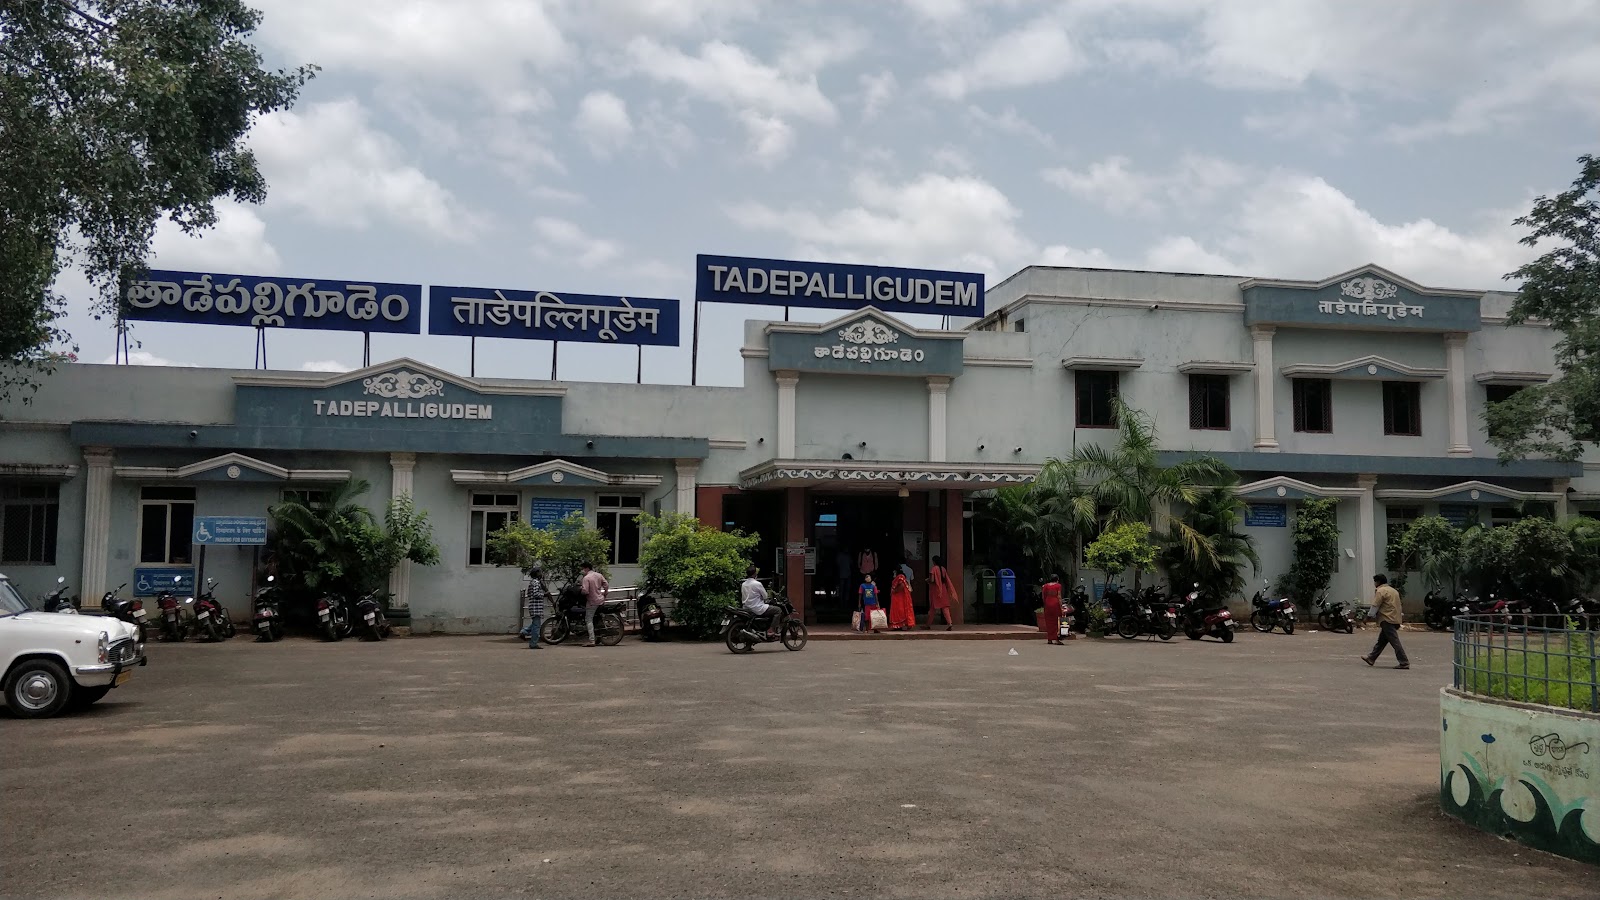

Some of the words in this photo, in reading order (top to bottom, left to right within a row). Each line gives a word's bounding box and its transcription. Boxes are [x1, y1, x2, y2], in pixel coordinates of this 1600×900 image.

[127, 274, 410, 327] తాడేపల్లిగూడెం
[707, 264, 977, 307] TADEPALLIGUDEM
[450, 290, 661, 341] ताडेपल्लिगूडेम
[1318, 298, 1425, 320] ताडेपल्लिगूडेम
[313, 399, 493, 420] TADEPALLIGUDEM
